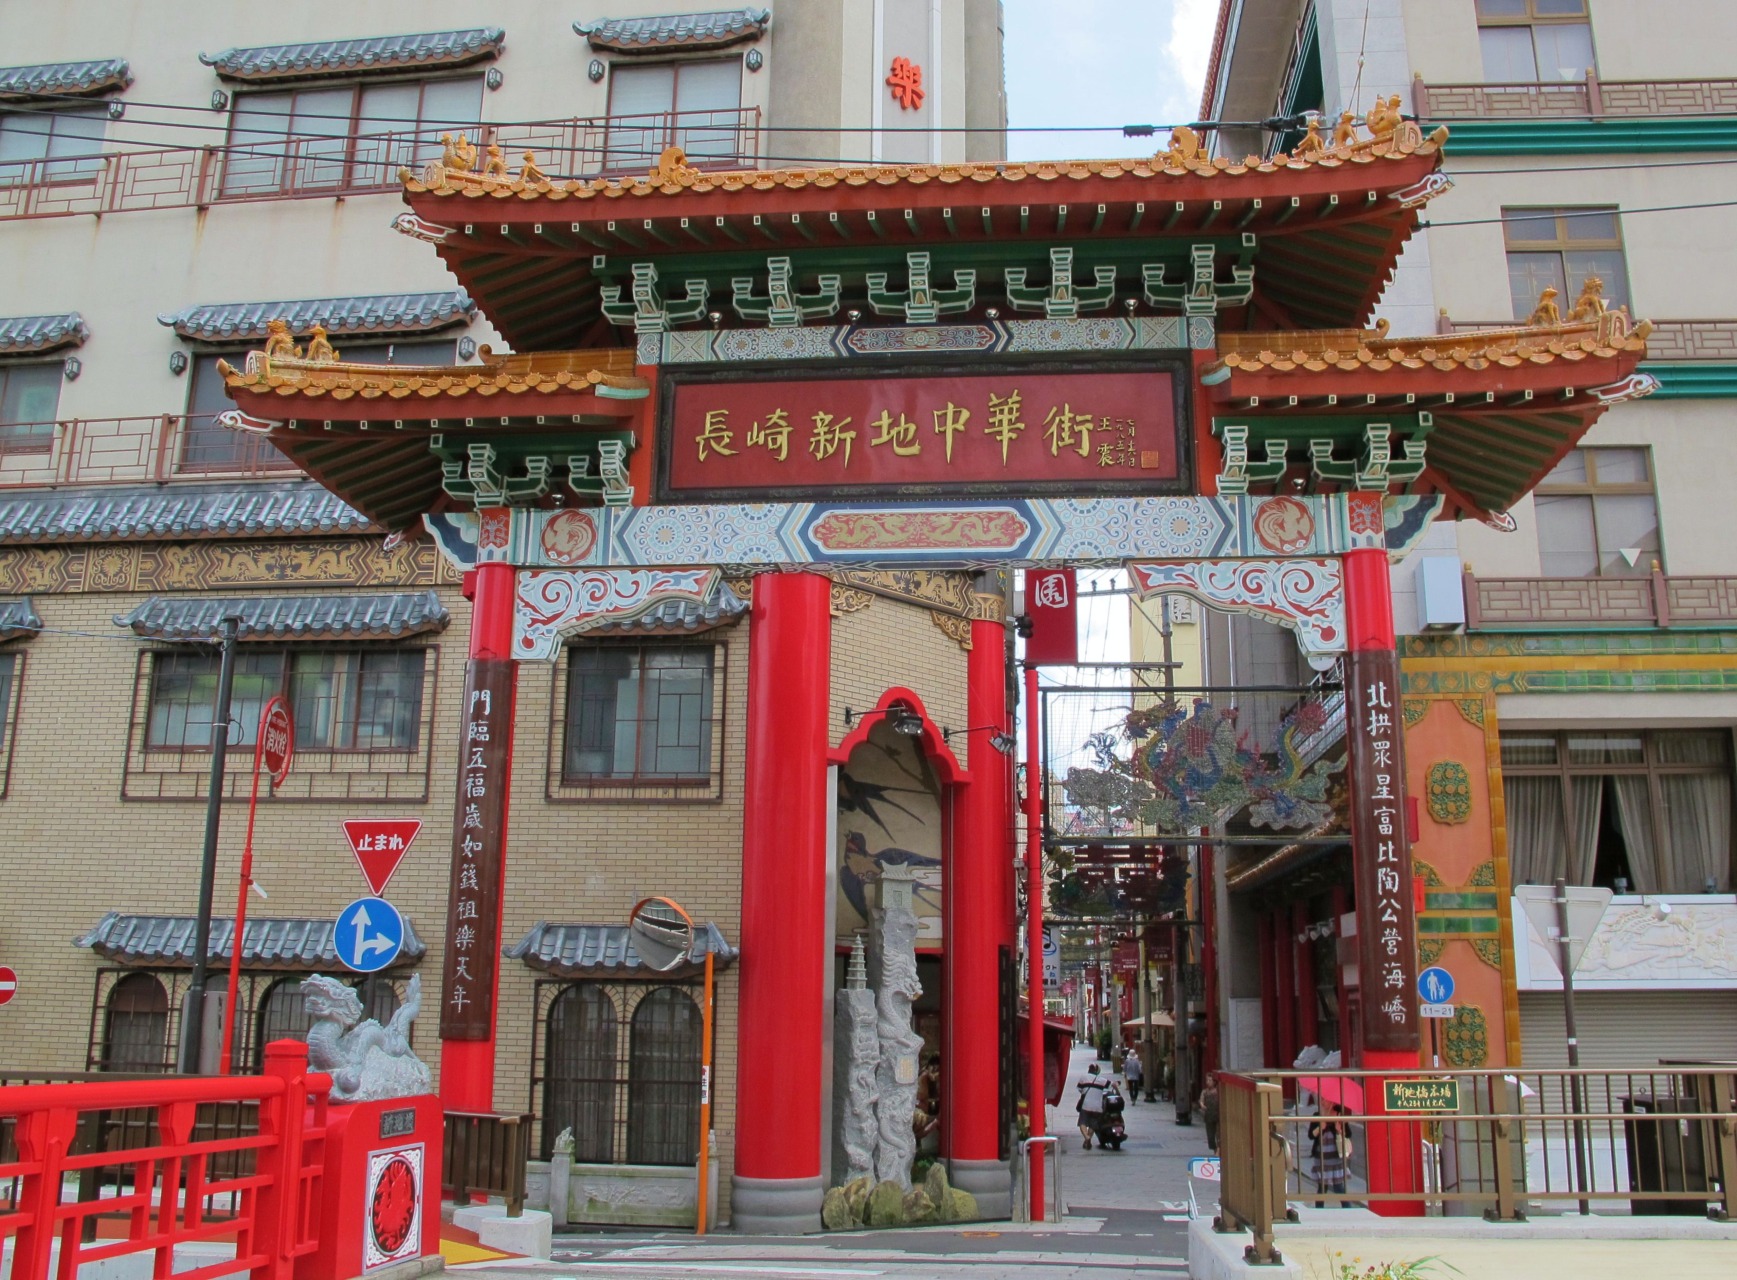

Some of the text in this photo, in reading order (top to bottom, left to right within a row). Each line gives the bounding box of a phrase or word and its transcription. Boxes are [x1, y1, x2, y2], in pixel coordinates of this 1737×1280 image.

[695, 389, 1094, 468] 長崎新地中華街
[266, 726, 287, 757] 消火栓
[357, 833, 404, 851] 止まれ
[1423, 1007, 1452, 1016] 11-21
